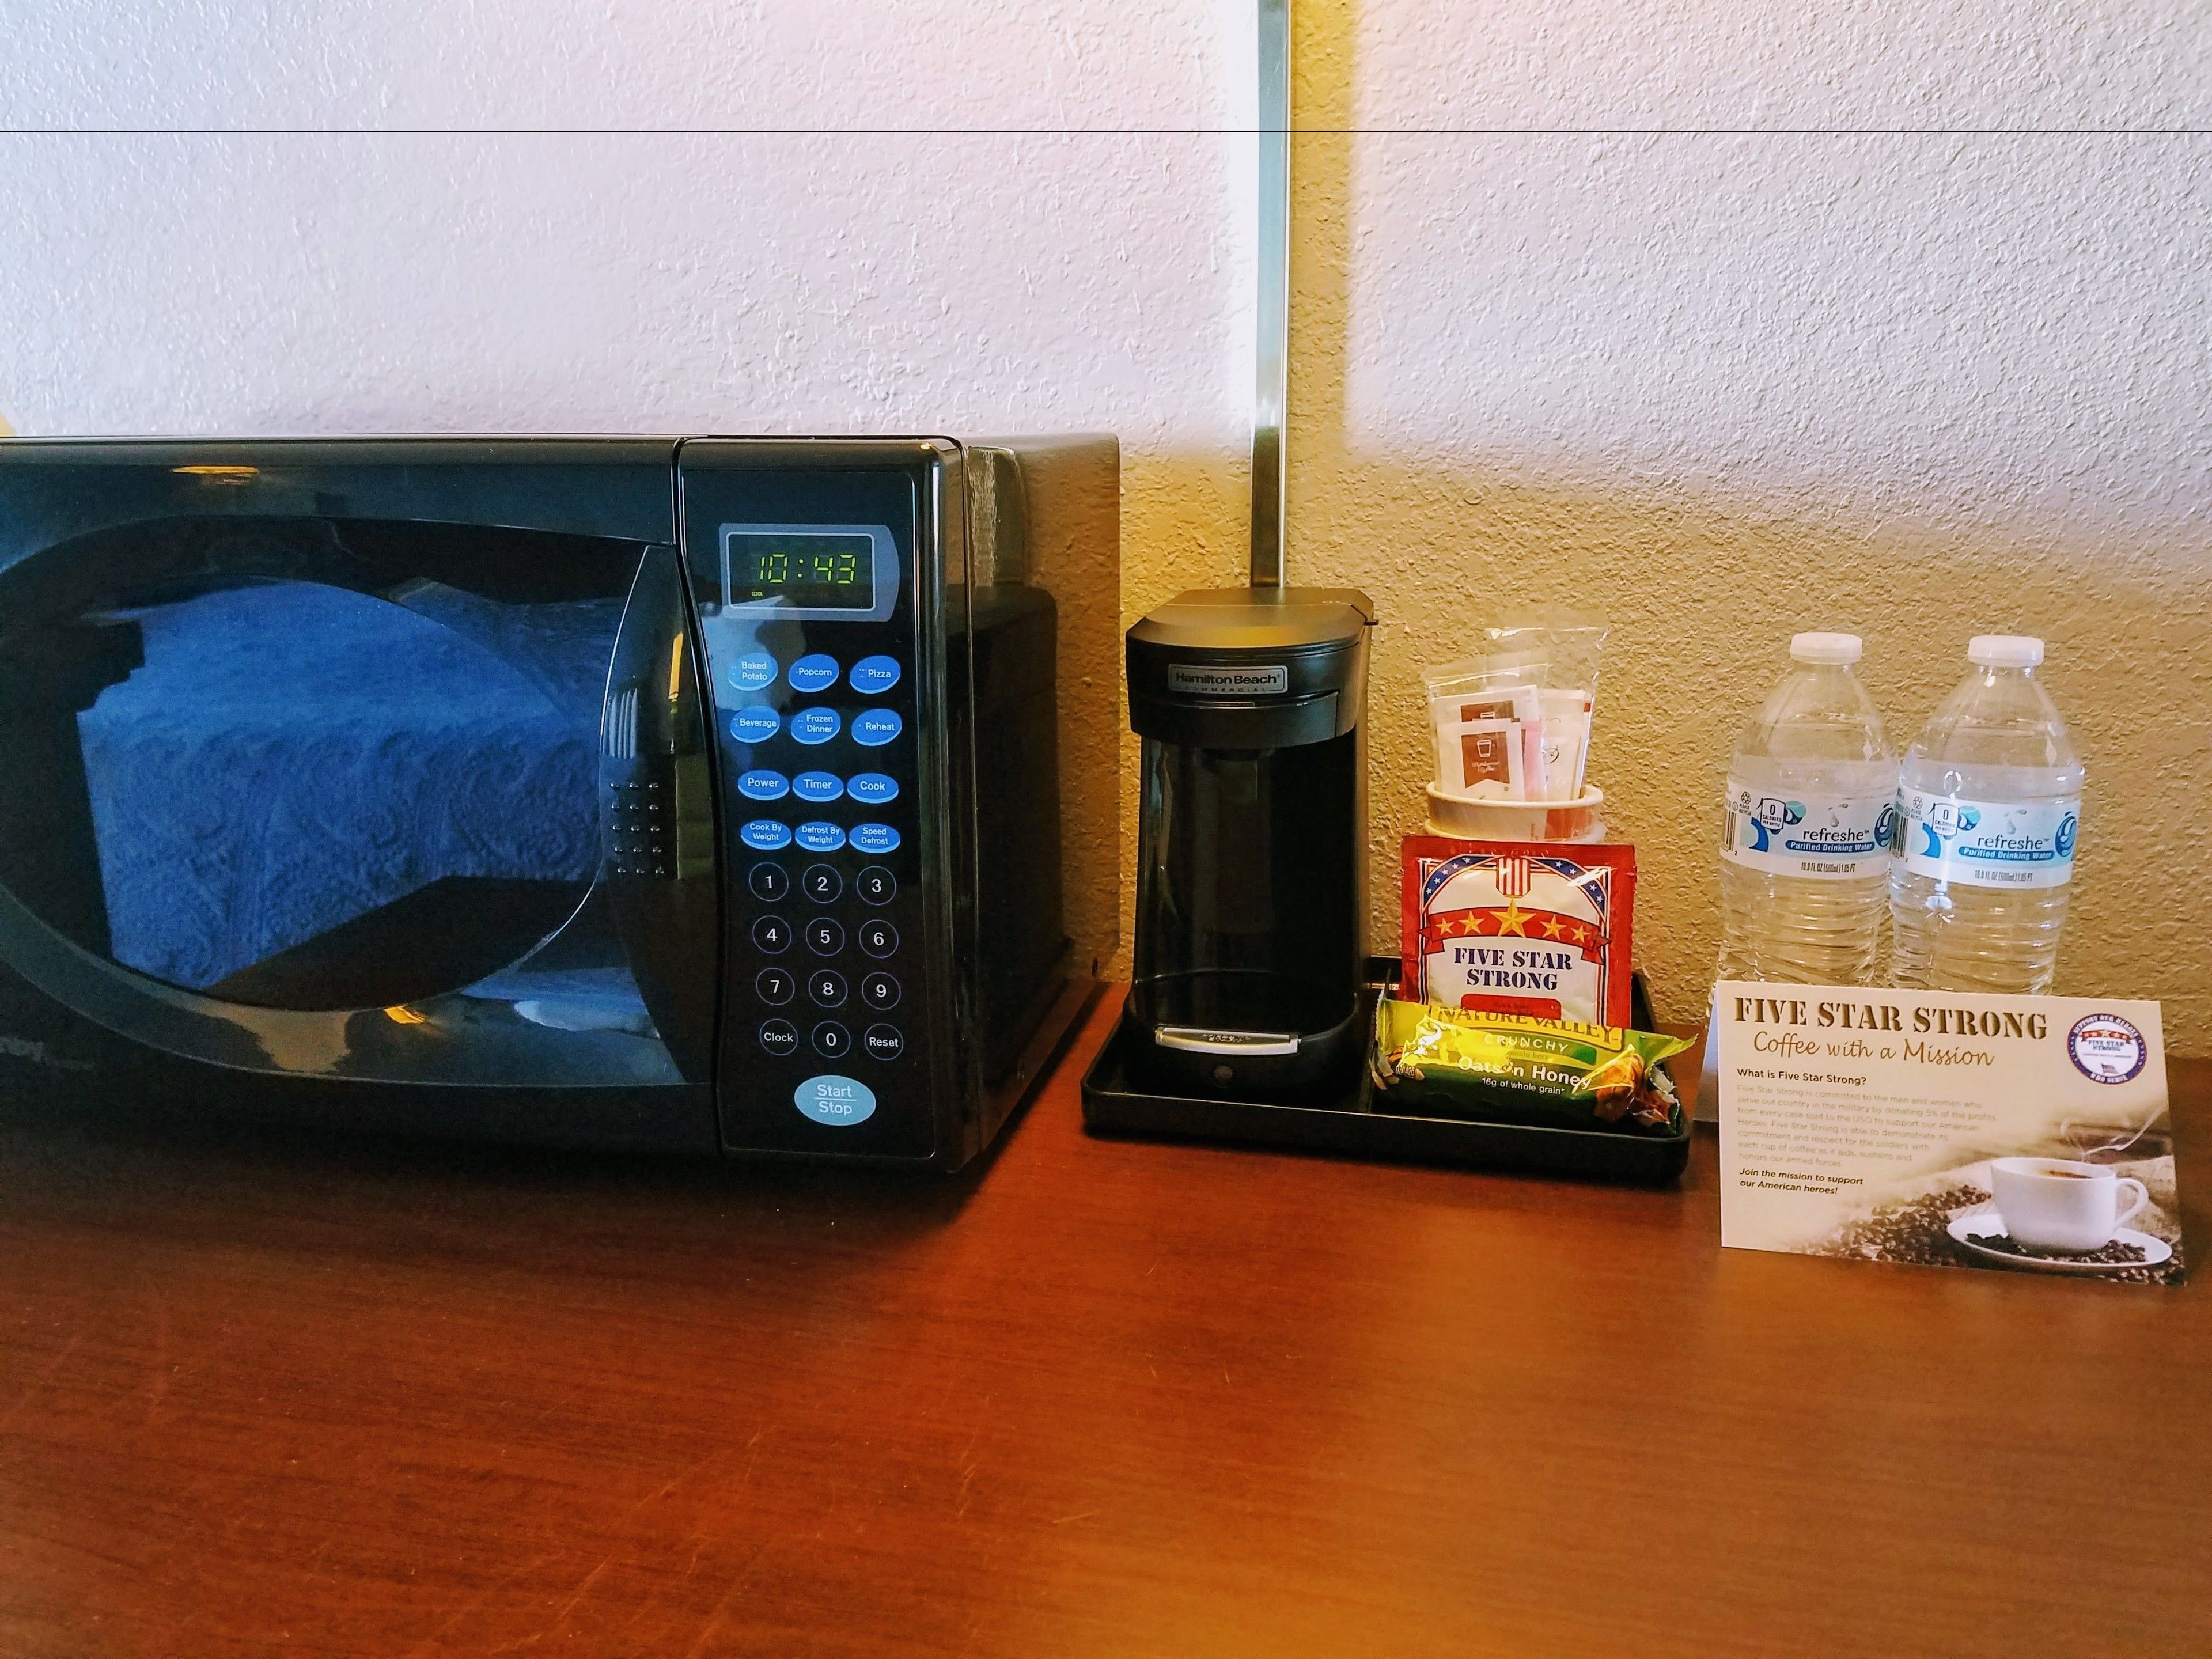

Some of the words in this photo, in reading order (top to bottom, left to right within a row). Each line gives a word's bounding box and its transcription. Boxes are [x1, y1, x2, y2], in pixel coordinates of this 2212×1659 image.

[759, 554, 857, 584] 10:43
[741, 661, 767, 671] Baked
[741, 672, 768, 681] Potato
[798, 668, 832, 677] Popcorn
[868, 669, 892, 679] Pizza
[1176, 672, 1232, 684] Hamilton
[740, 718, 777, 728] Beverage
[806, 714, 834, 724] Frozen
[806, 725, 833, 733] Dinner
[865, 722, 895, 732] Reheat
[748, 777, 779, 788] Power
[804, 779, 833, 790] Timer
[860, 781, 886, 791] Cook
[1770, 804, 1776, 815] 0
[1943, 809, 1949, 820] 0
[772, 824, 782, 832] By
[802, 826, 829, 834] Defrost
[831, 827, 840, 835] By
[863, 827, 887, 836] Speed
[752, 833, 780, 841] Weight
[808, 836, 834, 844] Weight
[861, 837, 889, 845] Defrost
[1790, 842, 1820, 851] Purified
[1823, 844, 1853, 853] Drinking
[1963, 847, 1996, 858] Purified
[1998, 850, 2030, 861] Drinking
[2032, 852, 2052, 860] Water
[765, 875, 773, 889] 1
[817, 876, 828, 891] 2
[871, 878, 882, 893] 3
[767, 928, 778, 942] 4
[820, 930, 831, 944] 5
[873, 931, 885, 946] 6
[1453, 948, 1505, 967] FIVE
[1512, 950, 1573, 971] STAR
[1466, 968, 1559, 991] STRONG
[770, 980, 780, 994] 7
[823, 982, 834, 995] 8
[876, 984, 887, 998] 9
[1734, 997, 1807, 1025] FIVE
[1817, 1002, 1903, 1031] STAR
[1912, 1007, 2047, 1040] STRONG
[1532, 1016, 1613, 1044] VALLEY
[764, 1031, 794, 1043] Clock
[825, 1032, 837, 1046] 0
[869, 1036, 899, 1048] Reset
[1483, 1033, 1569, 1053] CRUNCHY
[1753, 1031, 1821, 1058] Coffee
[1827, 1039, 1874, 1058] with
[1880, 1047, 1896, 1059] a
[1903, 1039, 1995, 1066] Mission
[1459, 1056, 1502, 1074] Oats
[1532, 1064, 1592, 1090] Honey
[1737, 1069, 1764, 1078] What
[1767, 1070, 1775, 1078] is
[1778, 1071, 1800, 1080] Five
[1802, 1073, 1823, 1082] Star
[1827, 1074, 1867, 1086] Strong?
[1482, 1077, 1497, 1088] 16g
[1499, 1079, 1509, 1088] of
[1510, 1081, 1536, 1092] whole
[817, 1084, 853, 1099] Start
[1757, 1085, 1773, 1094] Star
[1776, 1086, 1804, 1097] Strong
[819, 1101, 853, 1116] Stop
[1778, 1099, 1810, 1109] country
[1822, 1101, 1835, 1109] the
[1737, 1107, 1757, 1115] from
[1759, 1109, 1782, 1118] every
[1785, 1111, 1804, 1119] case
[1771, 1120, 1789, 1128] Five
[1791, 1122, 1808, 1130] Star
[1810, 1123, 1839, 1134] Strong
[1793, 1134, 1809, 1142] and
[1845, 1137, 1857, 1145] for
[1738, 1141, 1758, 1149] each
[1760, 1143, 1777, 1152] cup
[1778, 1143, 1787, 1152] of
[1738, 1152, 1767, 1161] honors
[1769, 1154, 1783, 1162] our
[1740, 1168, 1759, 1177] Join
[1762, 1169, 1776, 1177] the
[1778, 1171, 1813, 1181] mission
[1828, 1176, 1864, 1185] support
[1740, 1180, 1756, 1188] our
[1758, 1181, 1802, 1191] American
[1804, 1184, 1838, 1195] heroes!
